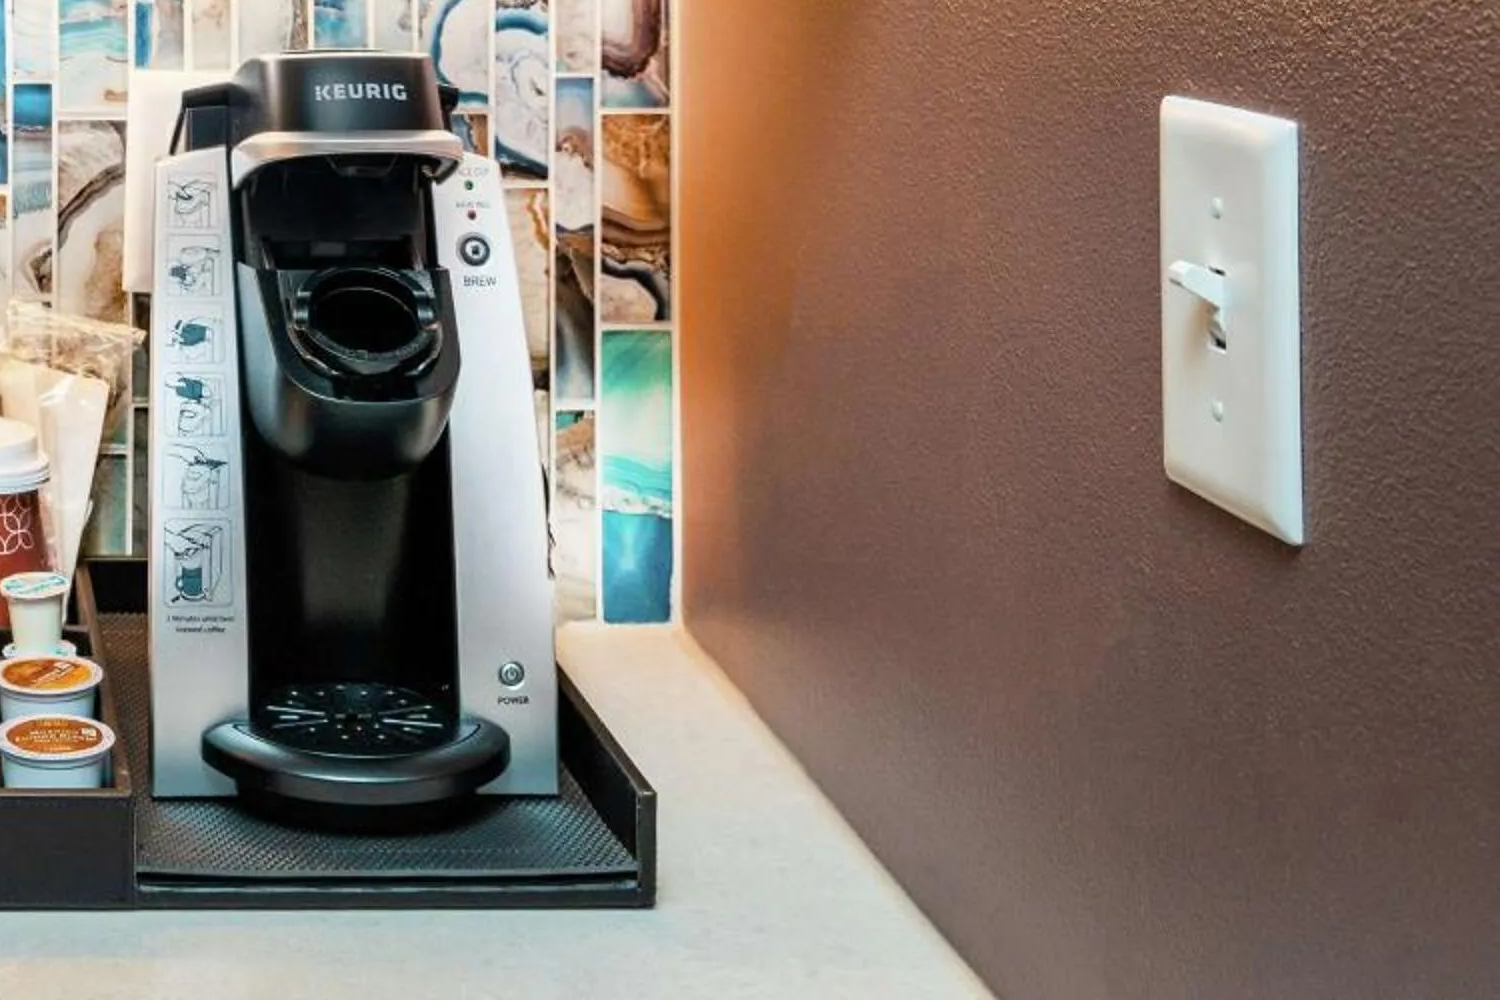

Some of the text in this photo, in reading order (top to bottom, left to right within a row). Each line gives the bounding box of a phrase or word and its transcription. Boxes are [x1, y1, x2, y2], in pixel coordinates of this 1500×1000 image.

[314, 83, 408, 101] KEURIG
[463, 275, 497, 287] BREW
[497, 696, 530, 705] POWER
